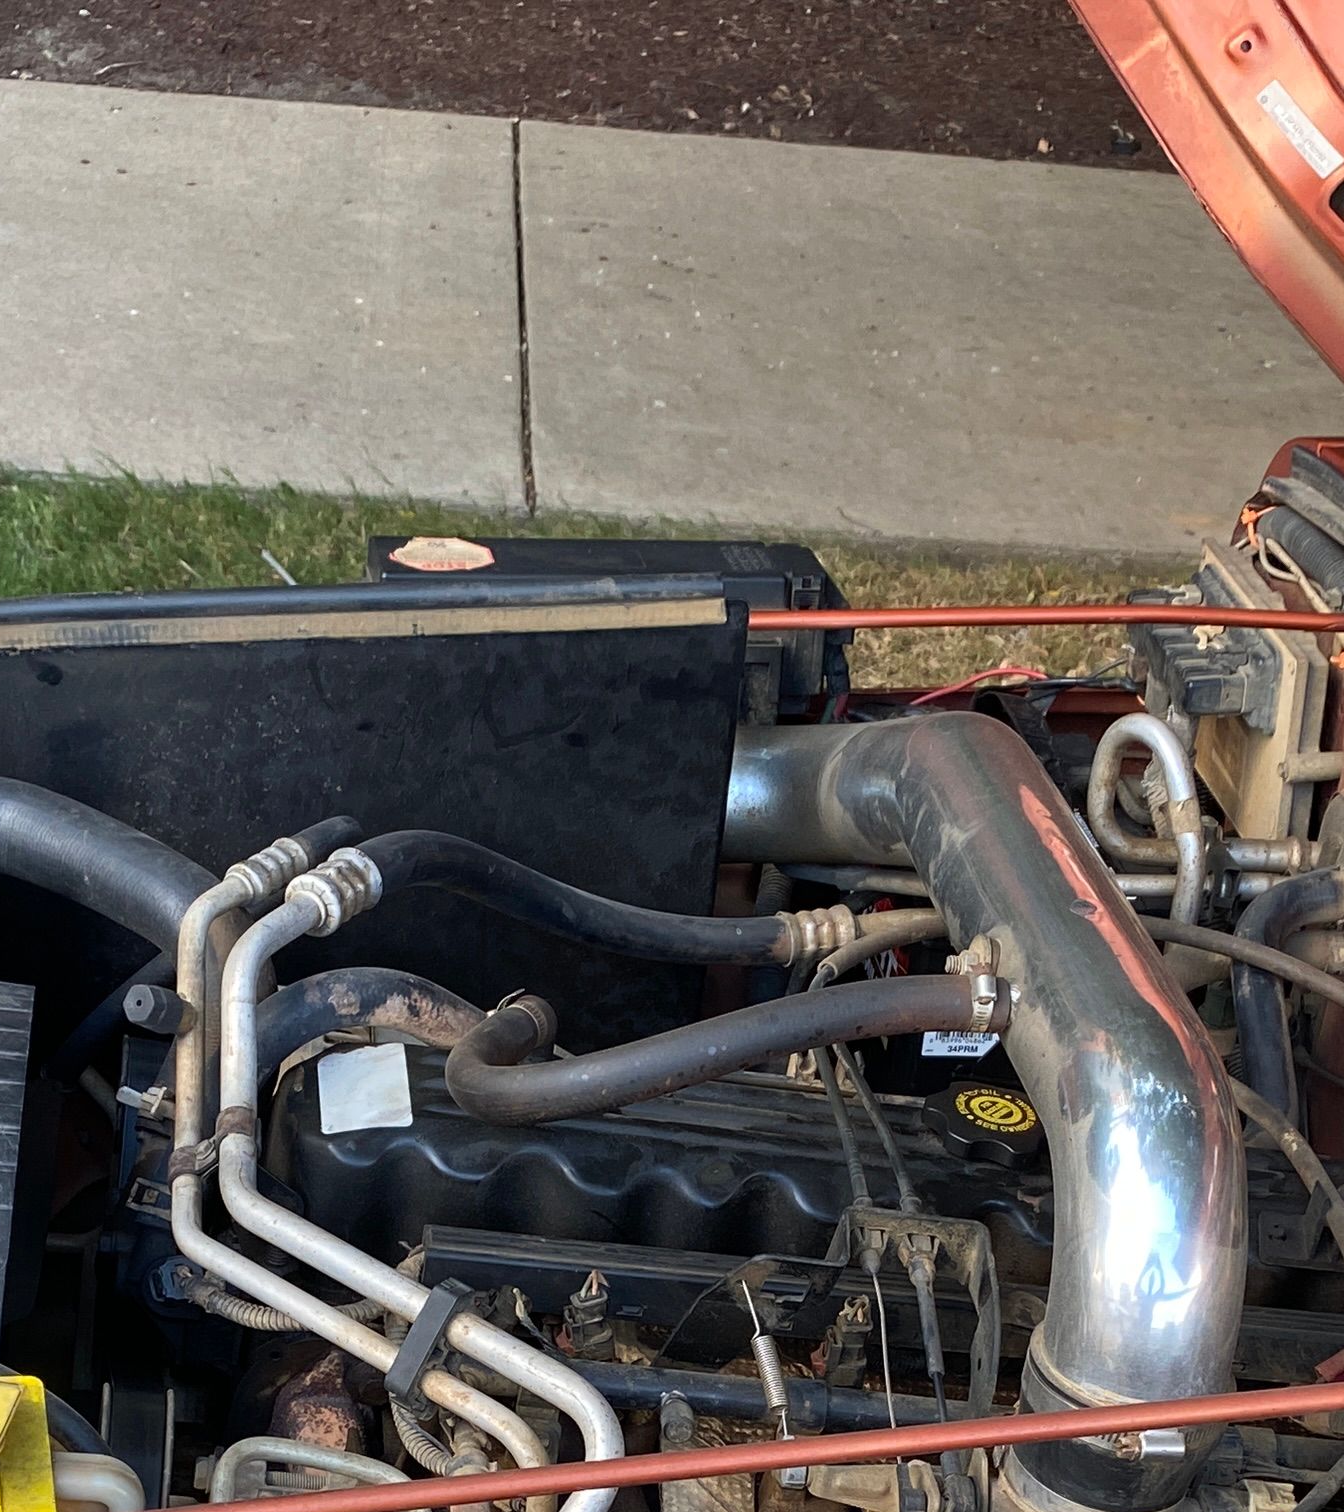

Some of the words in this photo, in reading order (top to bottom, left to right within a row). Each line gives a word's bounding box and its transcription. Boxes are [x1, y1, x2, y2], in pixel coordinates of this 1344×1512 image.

[947, 1045, 979, 1053] 34PRM
[981, 1089, 1001, 1097] OIL
[975, 1119, 999, 1131] SEE
